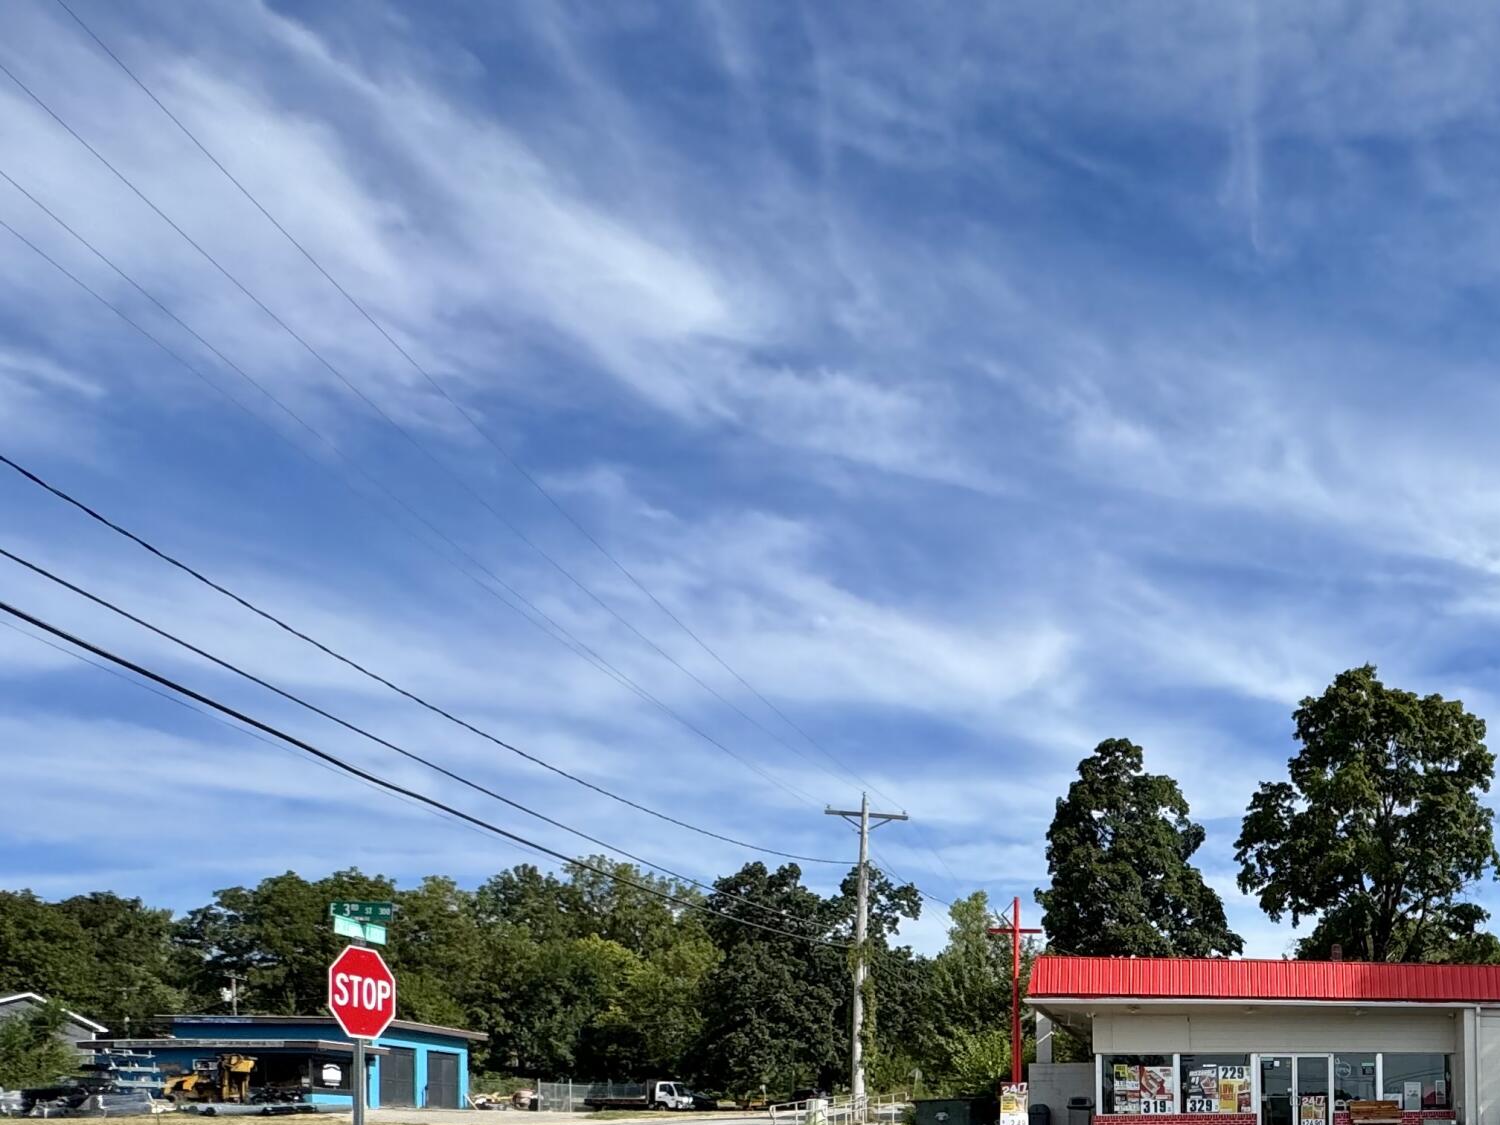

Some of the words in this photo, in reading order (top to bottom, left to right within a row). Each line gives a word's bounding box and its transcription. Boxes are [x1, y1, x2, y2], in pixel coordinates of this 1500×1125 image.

[330, 902, 337, 916] E
[334, 972, 391, 1011] STOP
[1221, 1066, 1244, 1079] 229
[1143, 1100, 1166, 1113] 319
[1190, 1099, 1213, 1112] 329
